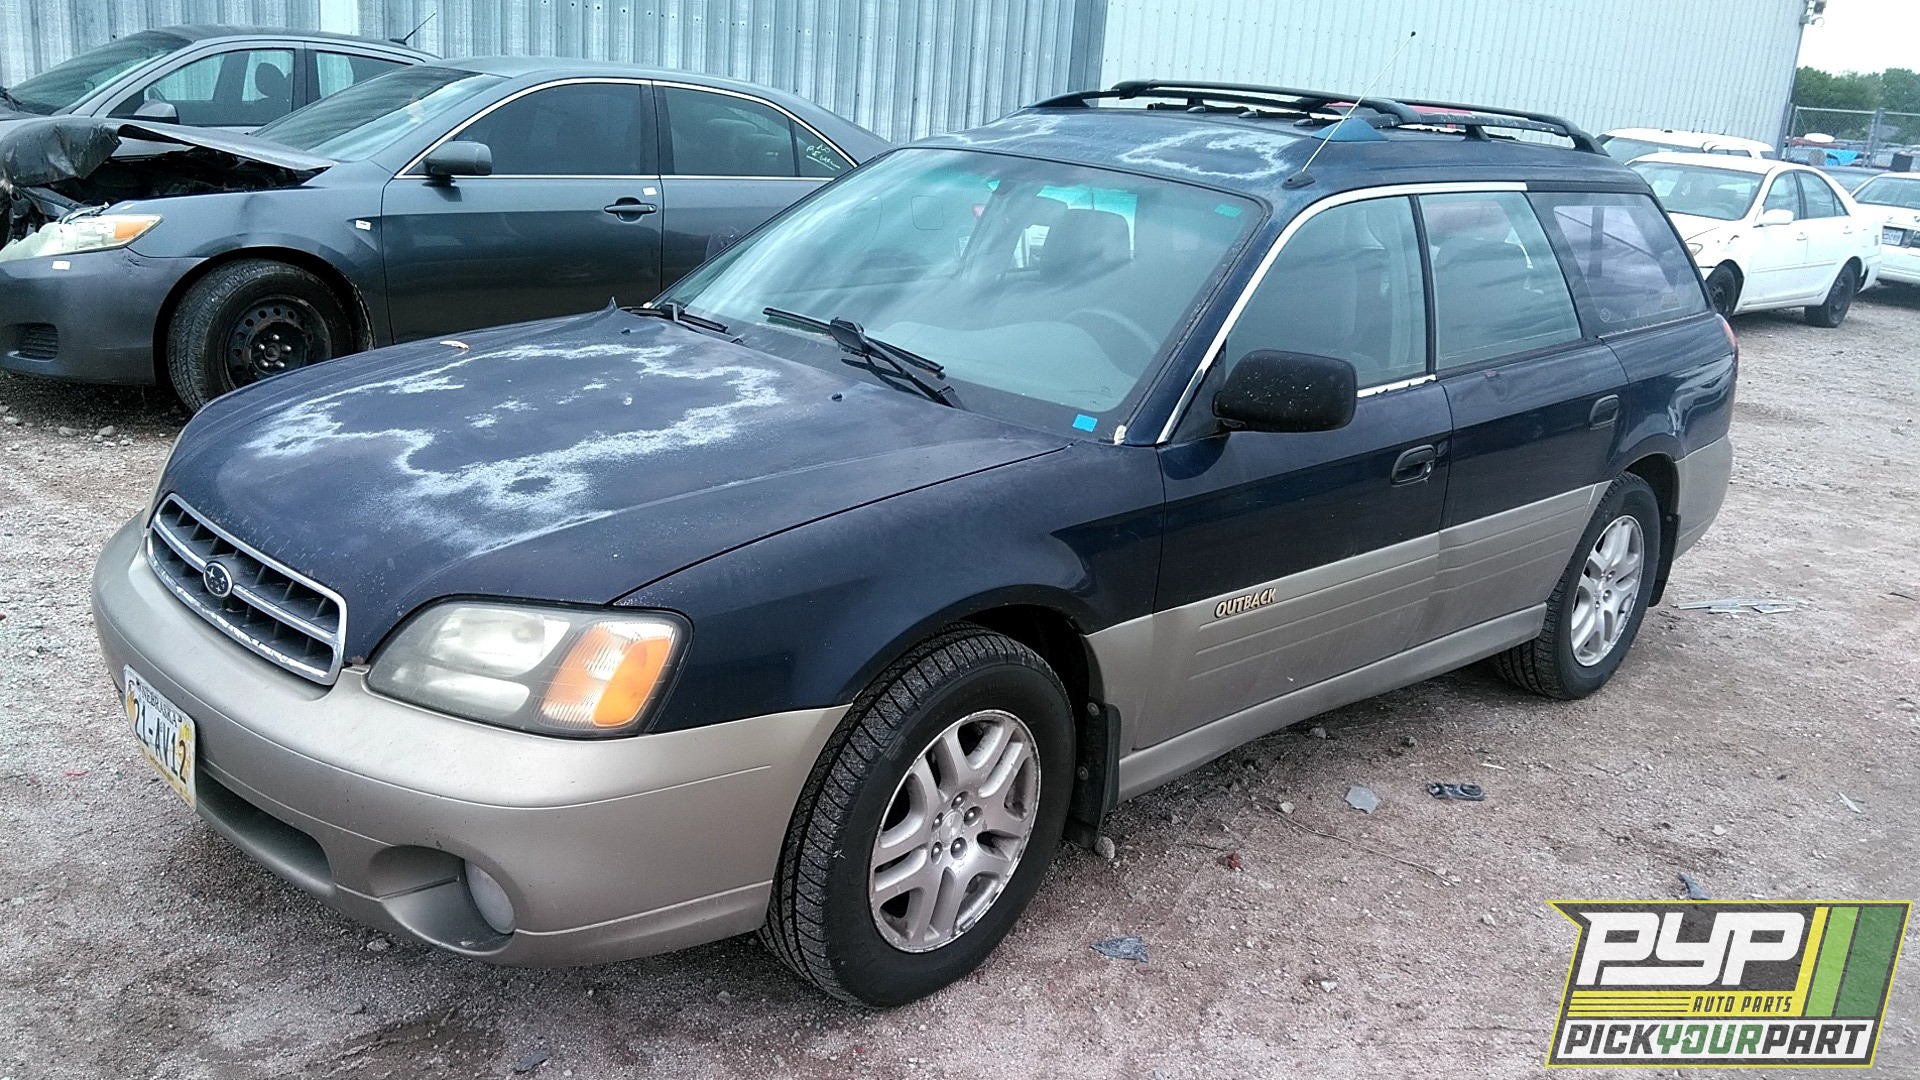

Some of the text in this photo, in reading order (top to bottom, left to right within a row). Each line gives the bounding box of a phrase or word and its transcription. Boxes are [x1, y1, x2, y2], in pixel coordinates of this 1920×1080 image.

[1214, 588, 1276, 618] OUTBACK
[140, 685, 179, 728] NEBRASKA
[133, 698, 187, 785] 21-AV12
